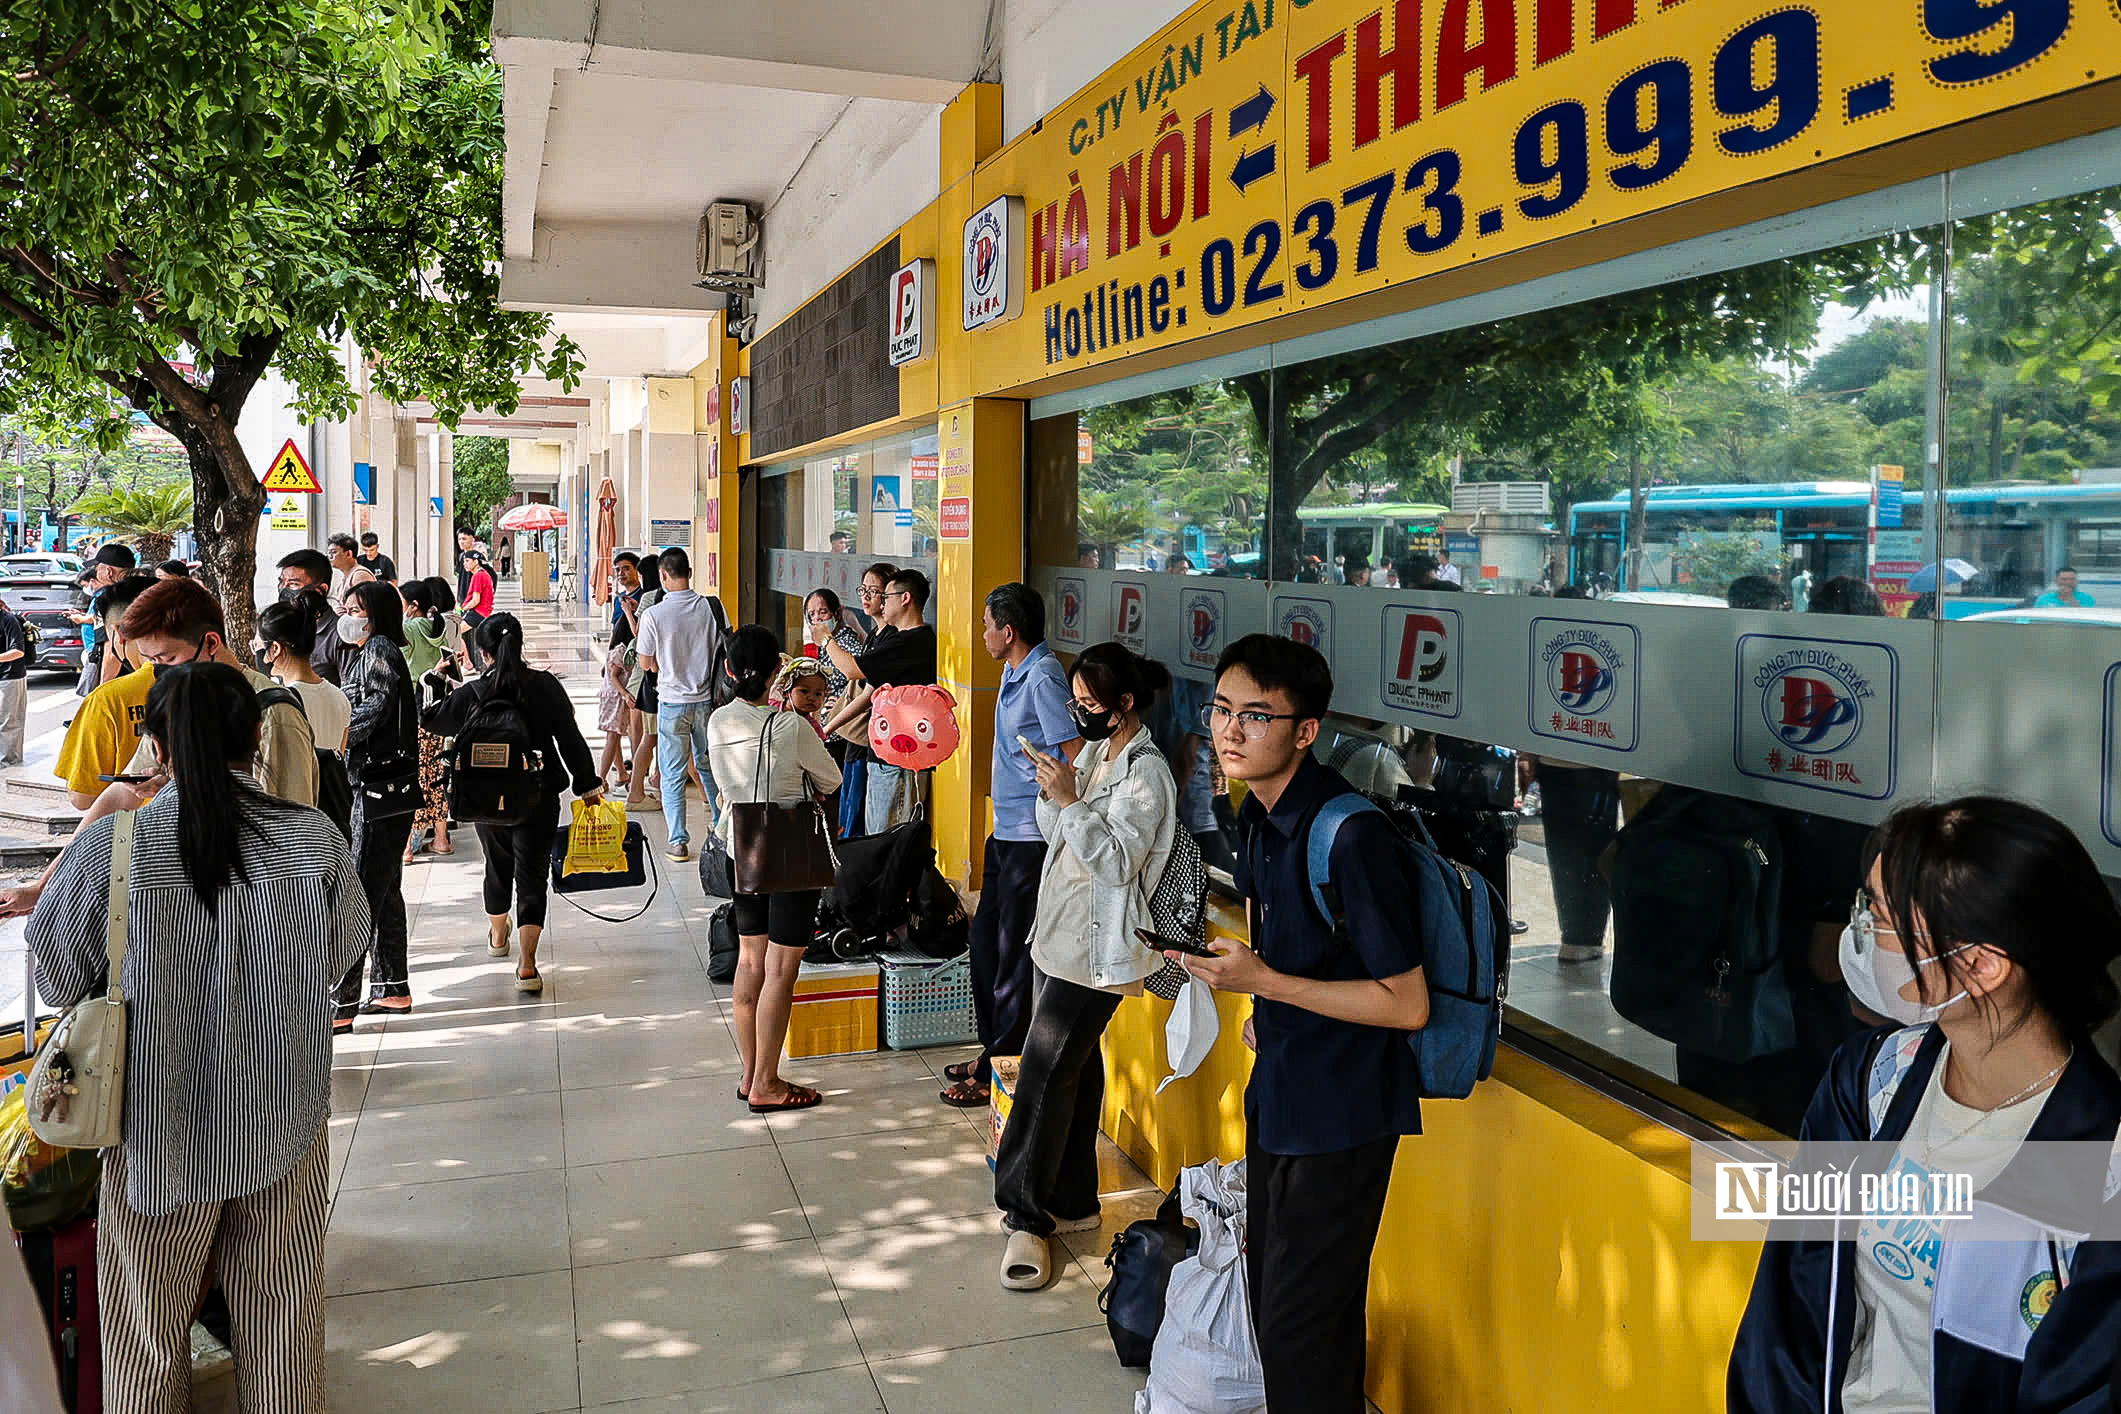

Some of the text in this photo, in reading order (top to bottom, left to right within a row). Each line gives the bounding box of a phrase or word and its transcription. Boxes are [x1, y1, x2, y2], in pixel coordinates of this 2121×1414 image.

[1069, 86, 1128, 156] C.TY
[1135, 33, 1204, 110] VẬN
[1031, 169, 1089, 293] HÀ
[1106, 108, 1214, 260] NỘI
[1044, 267, 1188, 365] Hotline:
[1787, 649, 1804, 665] TY
[1807, 649, 1837, 670] ĐỨC
